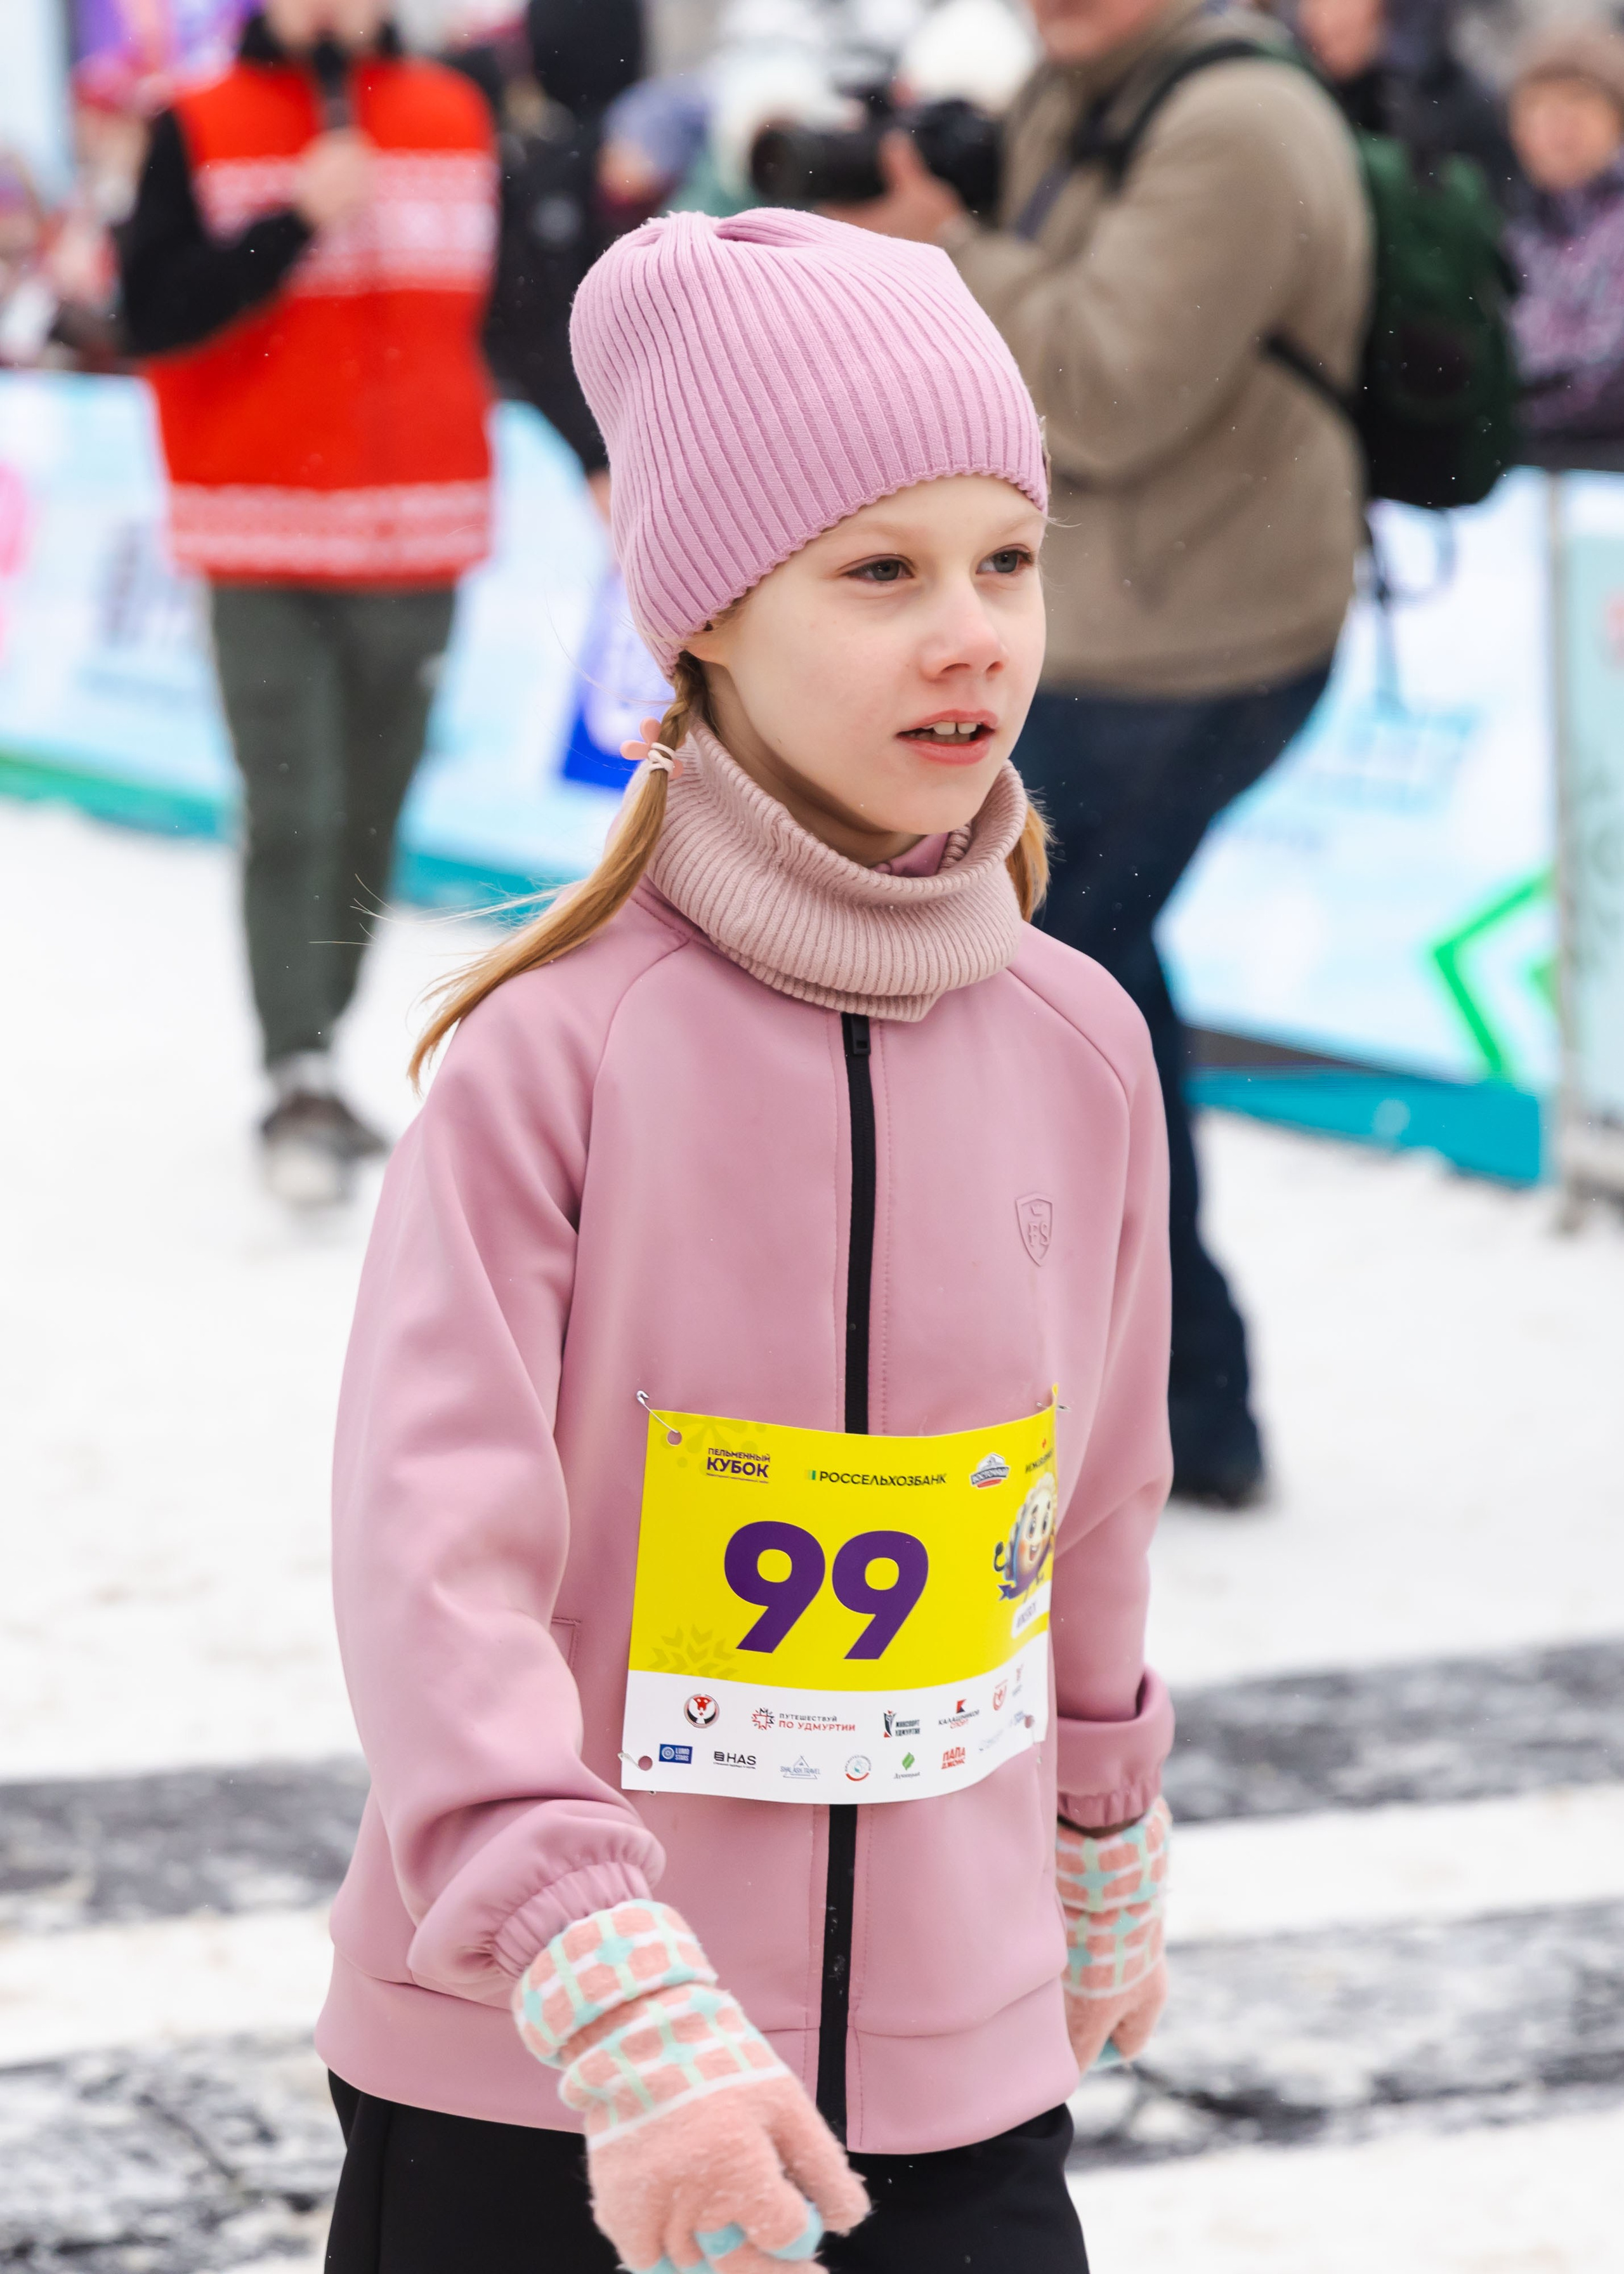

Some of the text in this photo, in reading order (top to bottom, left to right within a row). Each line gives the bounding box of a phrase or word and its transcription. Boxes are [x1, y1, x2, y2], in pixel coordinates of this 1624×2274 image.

[708, 1447, 771, 1462] ПЕЛЬМЕННЫЙ
[707, 1457, 769, 1478] КУБОК
[820, 1470, 947, 1486] РОССЕЛЬХОЗБАНК
[724, 1520, 929, 1660] 99
[779, 1713, 837, 1722] ПУТЕШЕСТВУЙ
[779, 1720, 856, 1732] ПО УДМУРТИИ
[726, 1752, 757, 1766] HAS
[943, 1747, 966, 1761] ПАПА
